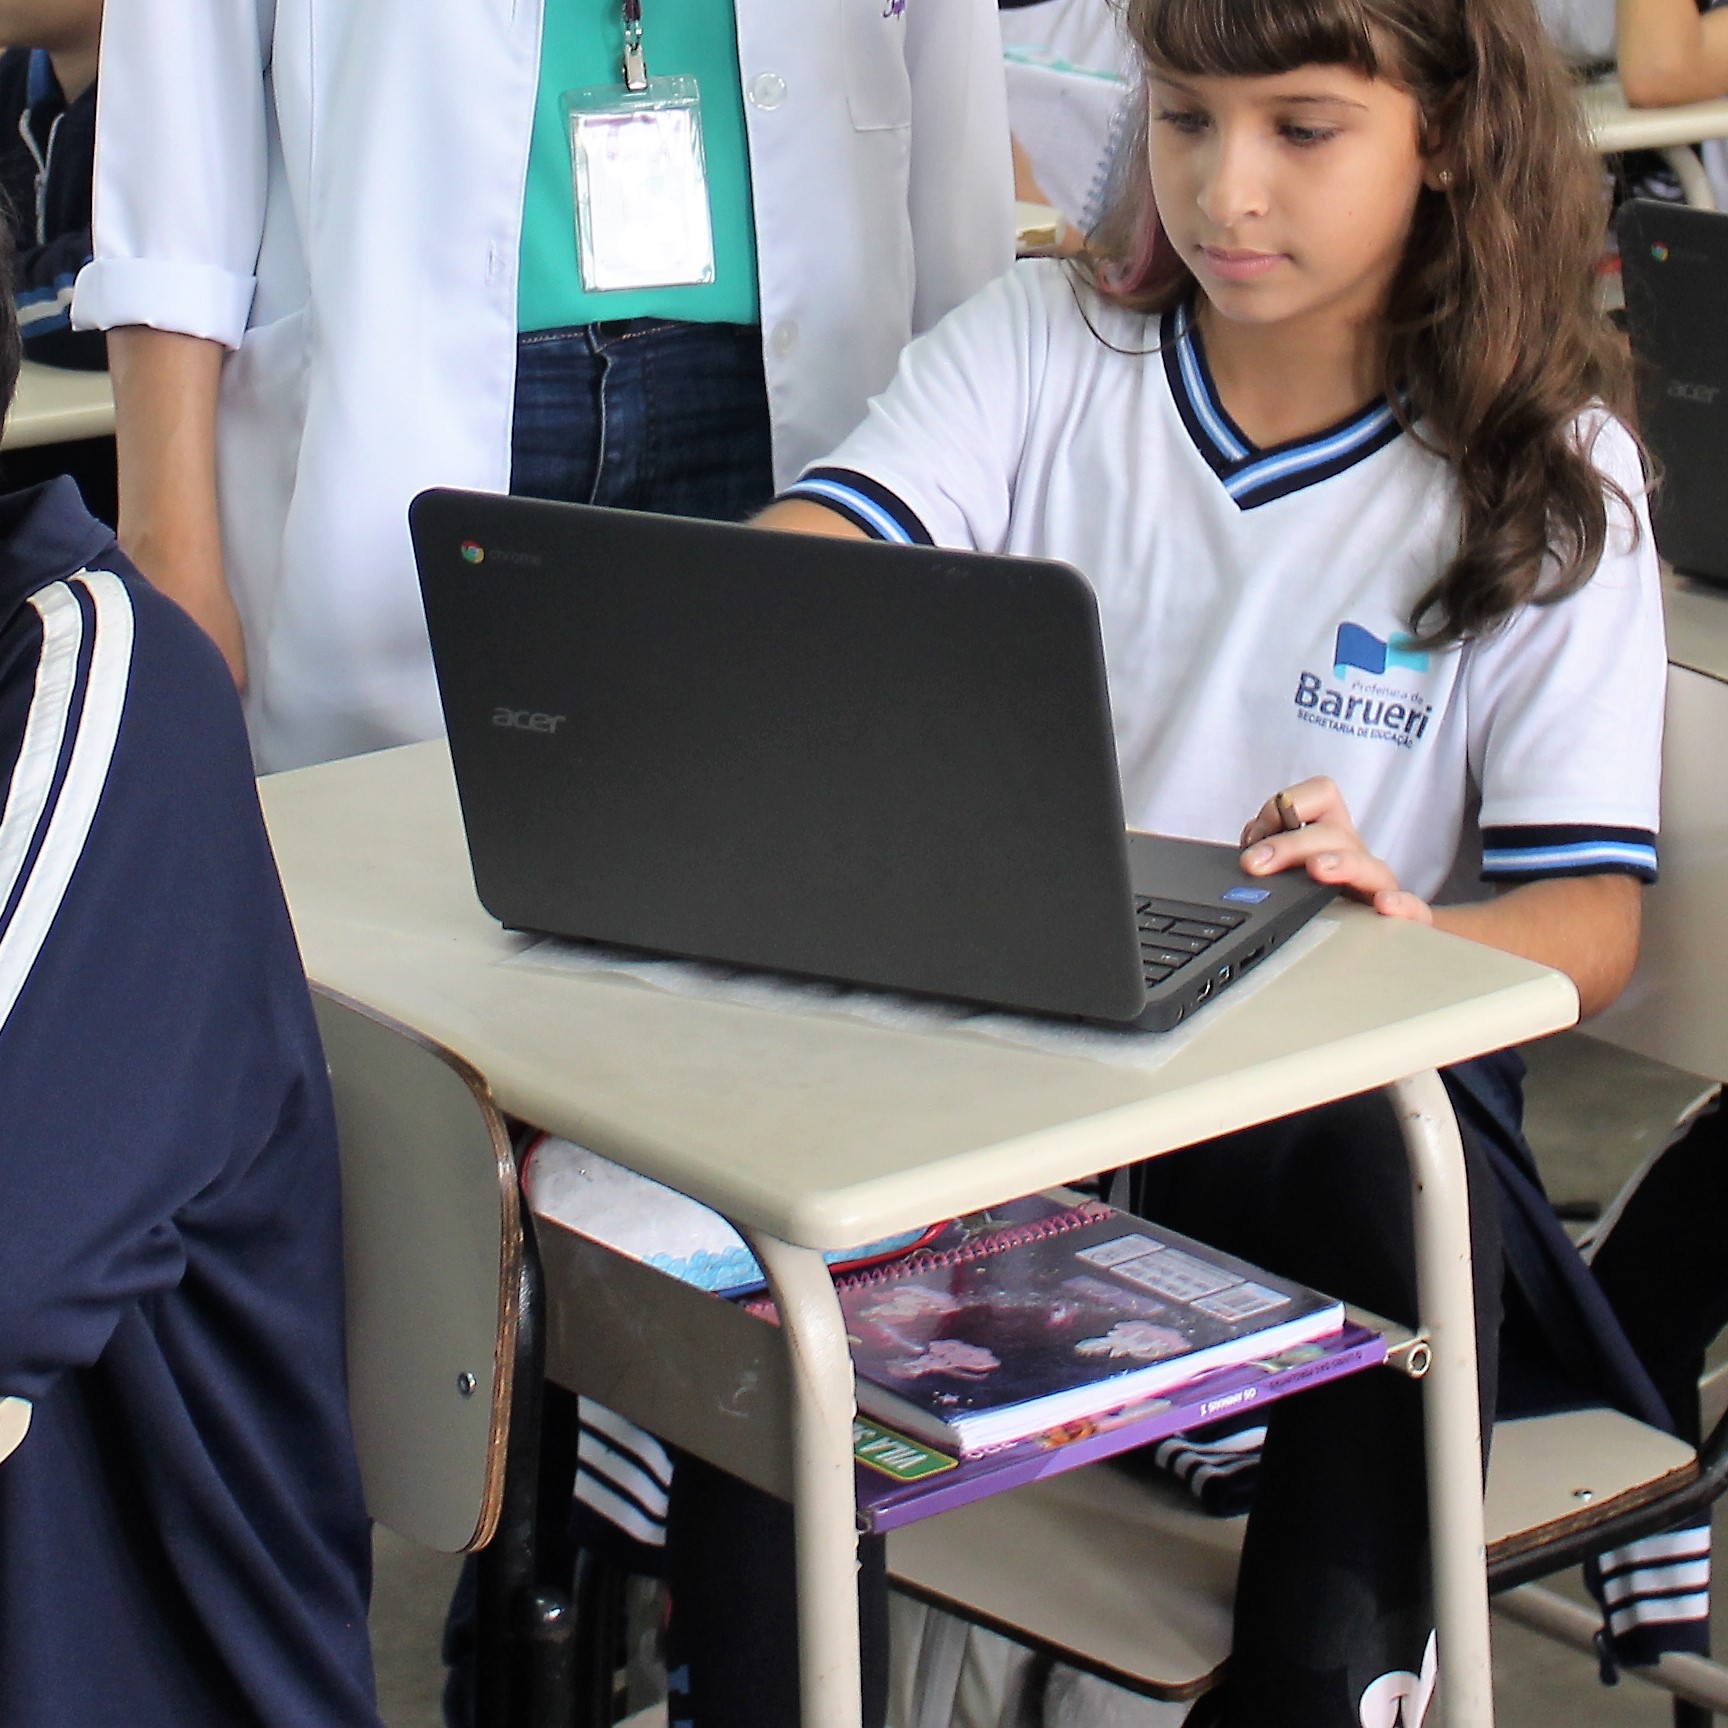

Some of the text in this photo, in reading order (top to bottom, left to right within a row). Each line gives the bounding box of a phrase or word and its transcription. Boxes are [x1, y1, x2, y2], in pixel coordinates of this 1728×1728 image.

[491, 706, 568, 734] acer
[1294, 670, 1433, 739] Barueri
[1297, 707, 1355, 736] SECRETARIA
[1356, 726, 1370, 739] DE
